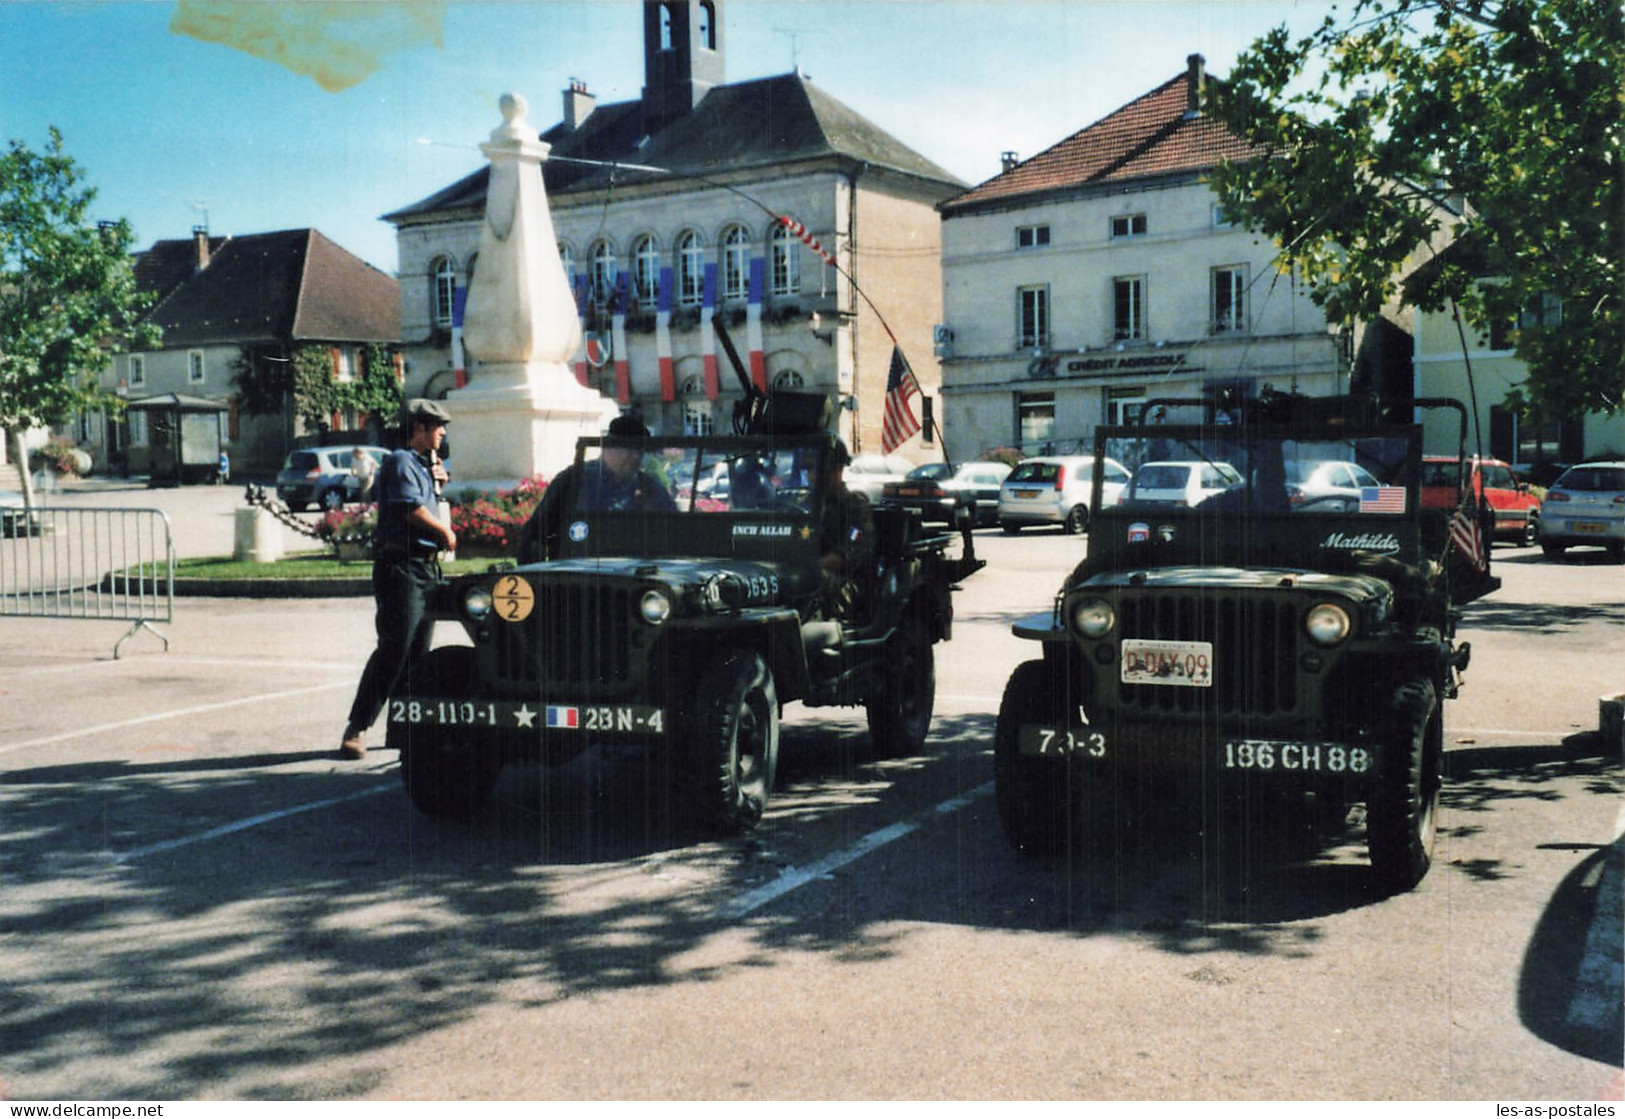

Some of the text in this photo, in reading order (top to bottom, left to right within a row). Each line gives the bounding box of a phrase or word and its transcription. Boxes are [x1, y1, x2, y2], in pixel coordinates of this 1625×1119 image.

[1118, 354, 1186, 367] AGRICOLE
[732, 525, 792, 535] INCH ALLAH
[1319, 532, 1400, 554] Mathilde
[507, 576, 519, 595] 2
[507, 599, 519, 619] 2
[1186, 653, 1208, 677] 09
[1226, 743, 1368, 773] 186 CH 88
